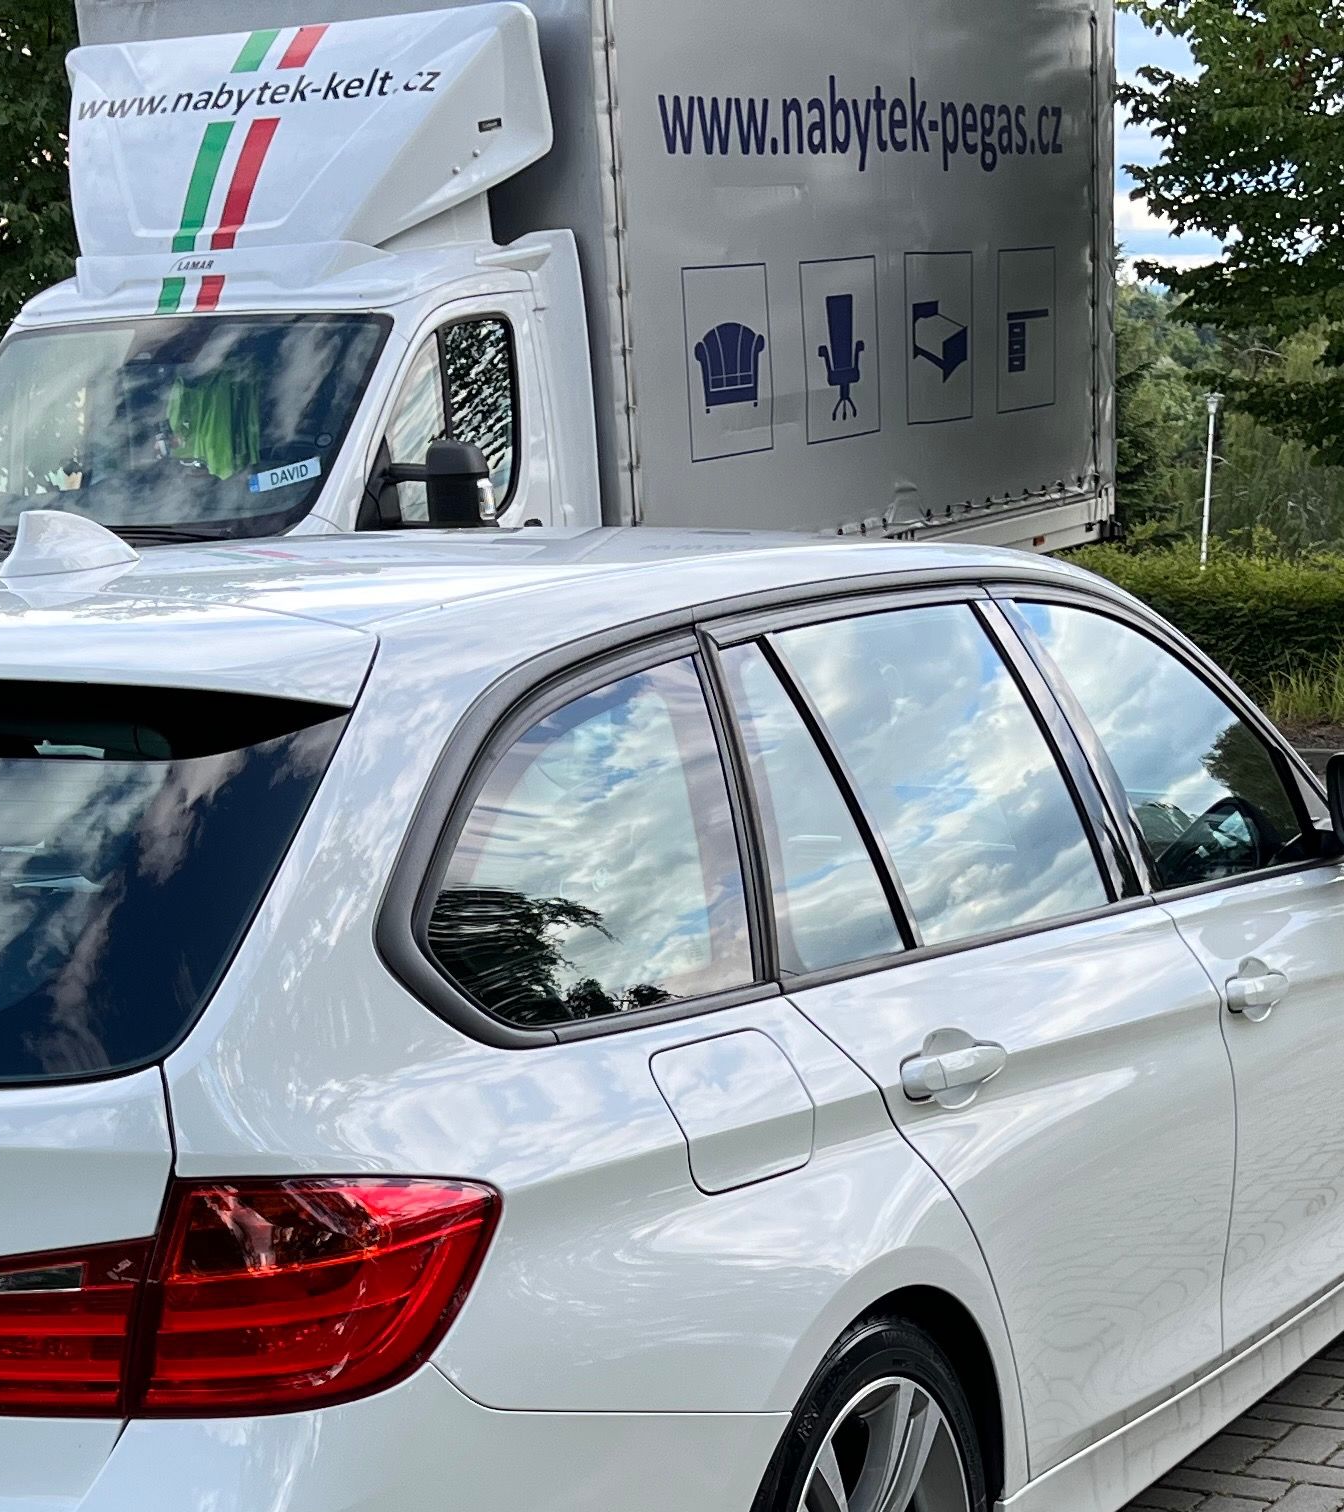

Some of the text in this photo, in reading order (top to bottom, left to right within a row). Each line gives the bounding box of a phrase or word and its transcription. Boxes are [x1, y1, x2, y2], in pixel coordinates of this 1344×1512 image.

[78, 68, 441, 120] www.nabytek-kelt.cz
[657, 75, 1063, 171] www.nabytek-pegas.cz
[270, 464, 309, 485] DAVID
